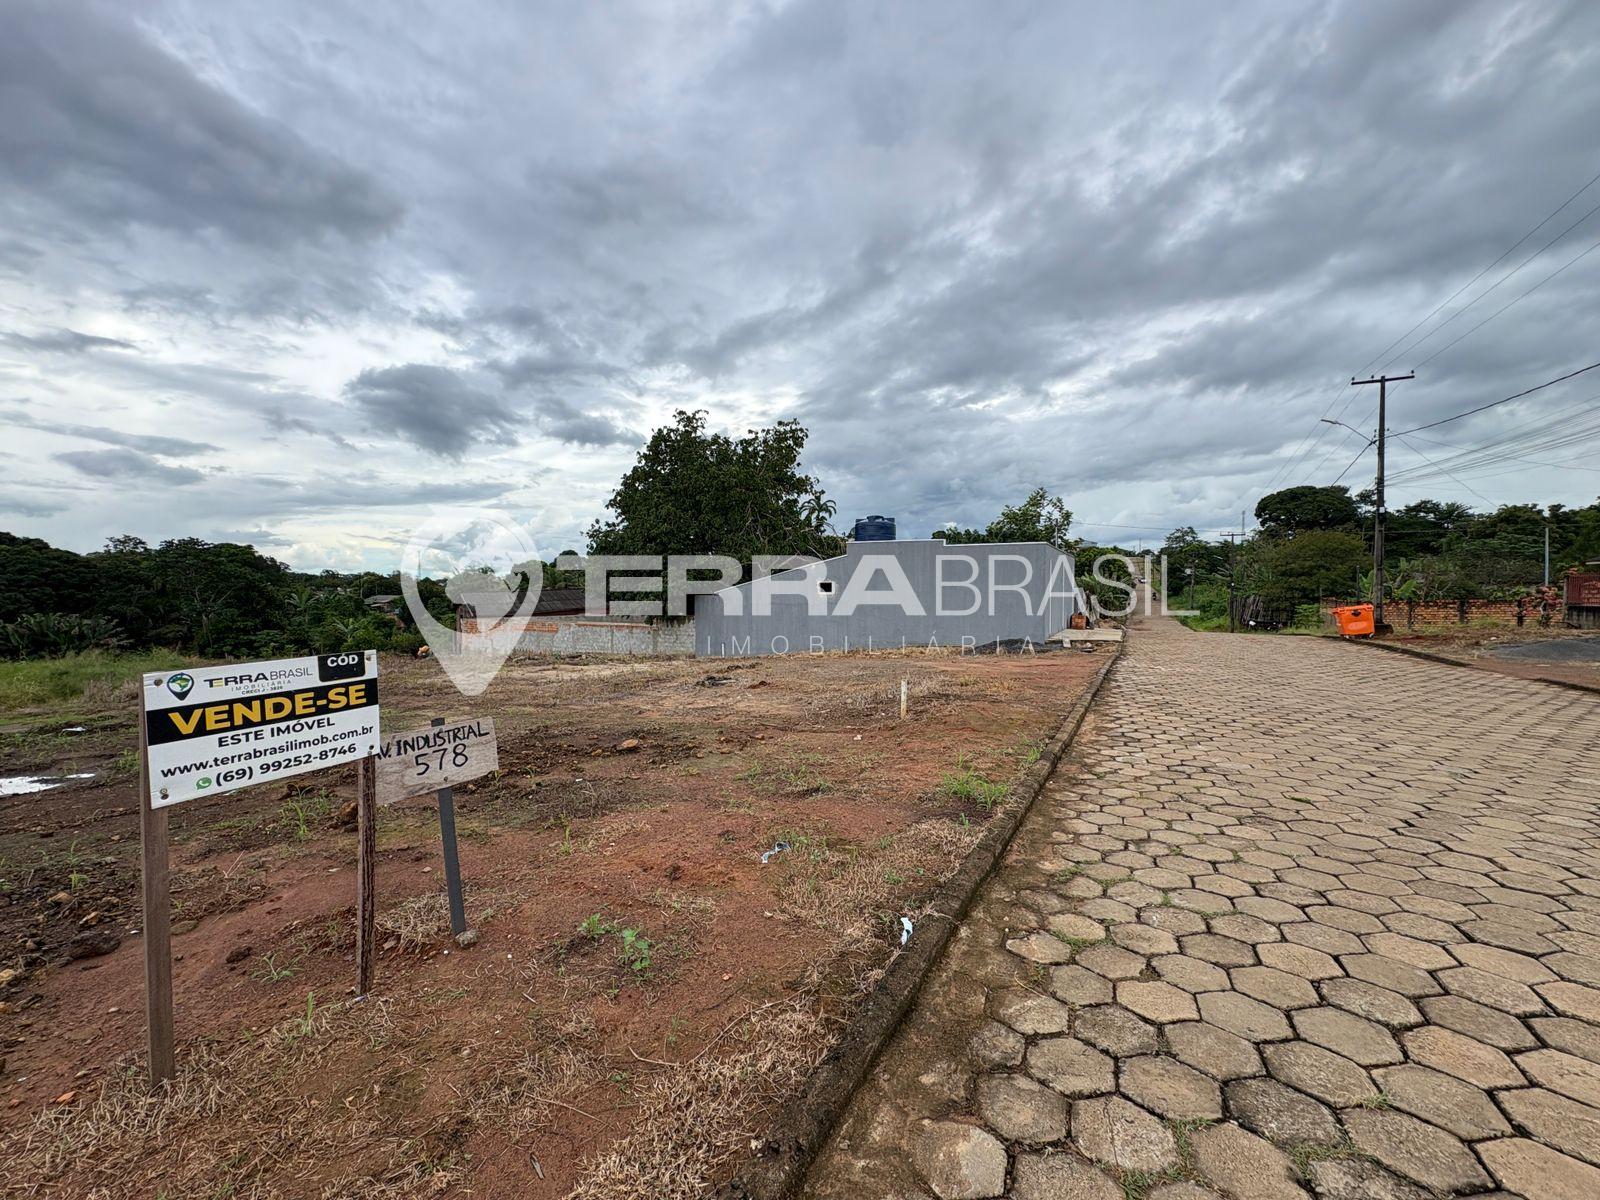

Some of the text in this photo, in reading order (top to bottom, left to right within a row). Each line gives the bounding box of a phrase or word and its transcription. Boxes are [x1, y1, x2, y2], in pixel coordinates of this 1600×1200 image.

[327, 653, 359, 667] CÓD
[168, 684, 367, 735] VENDE-SE
[161, 726, 374, 778] www.terrabrasilimob.com.br
[218, 717, 336, 748] ESTE IMÓVEL
[375, 721, 490, 760] V. INDUSTRIAL
[216, 743, 357, 786] (69) 99252-8746
[414, 743, 469, 776] 578
